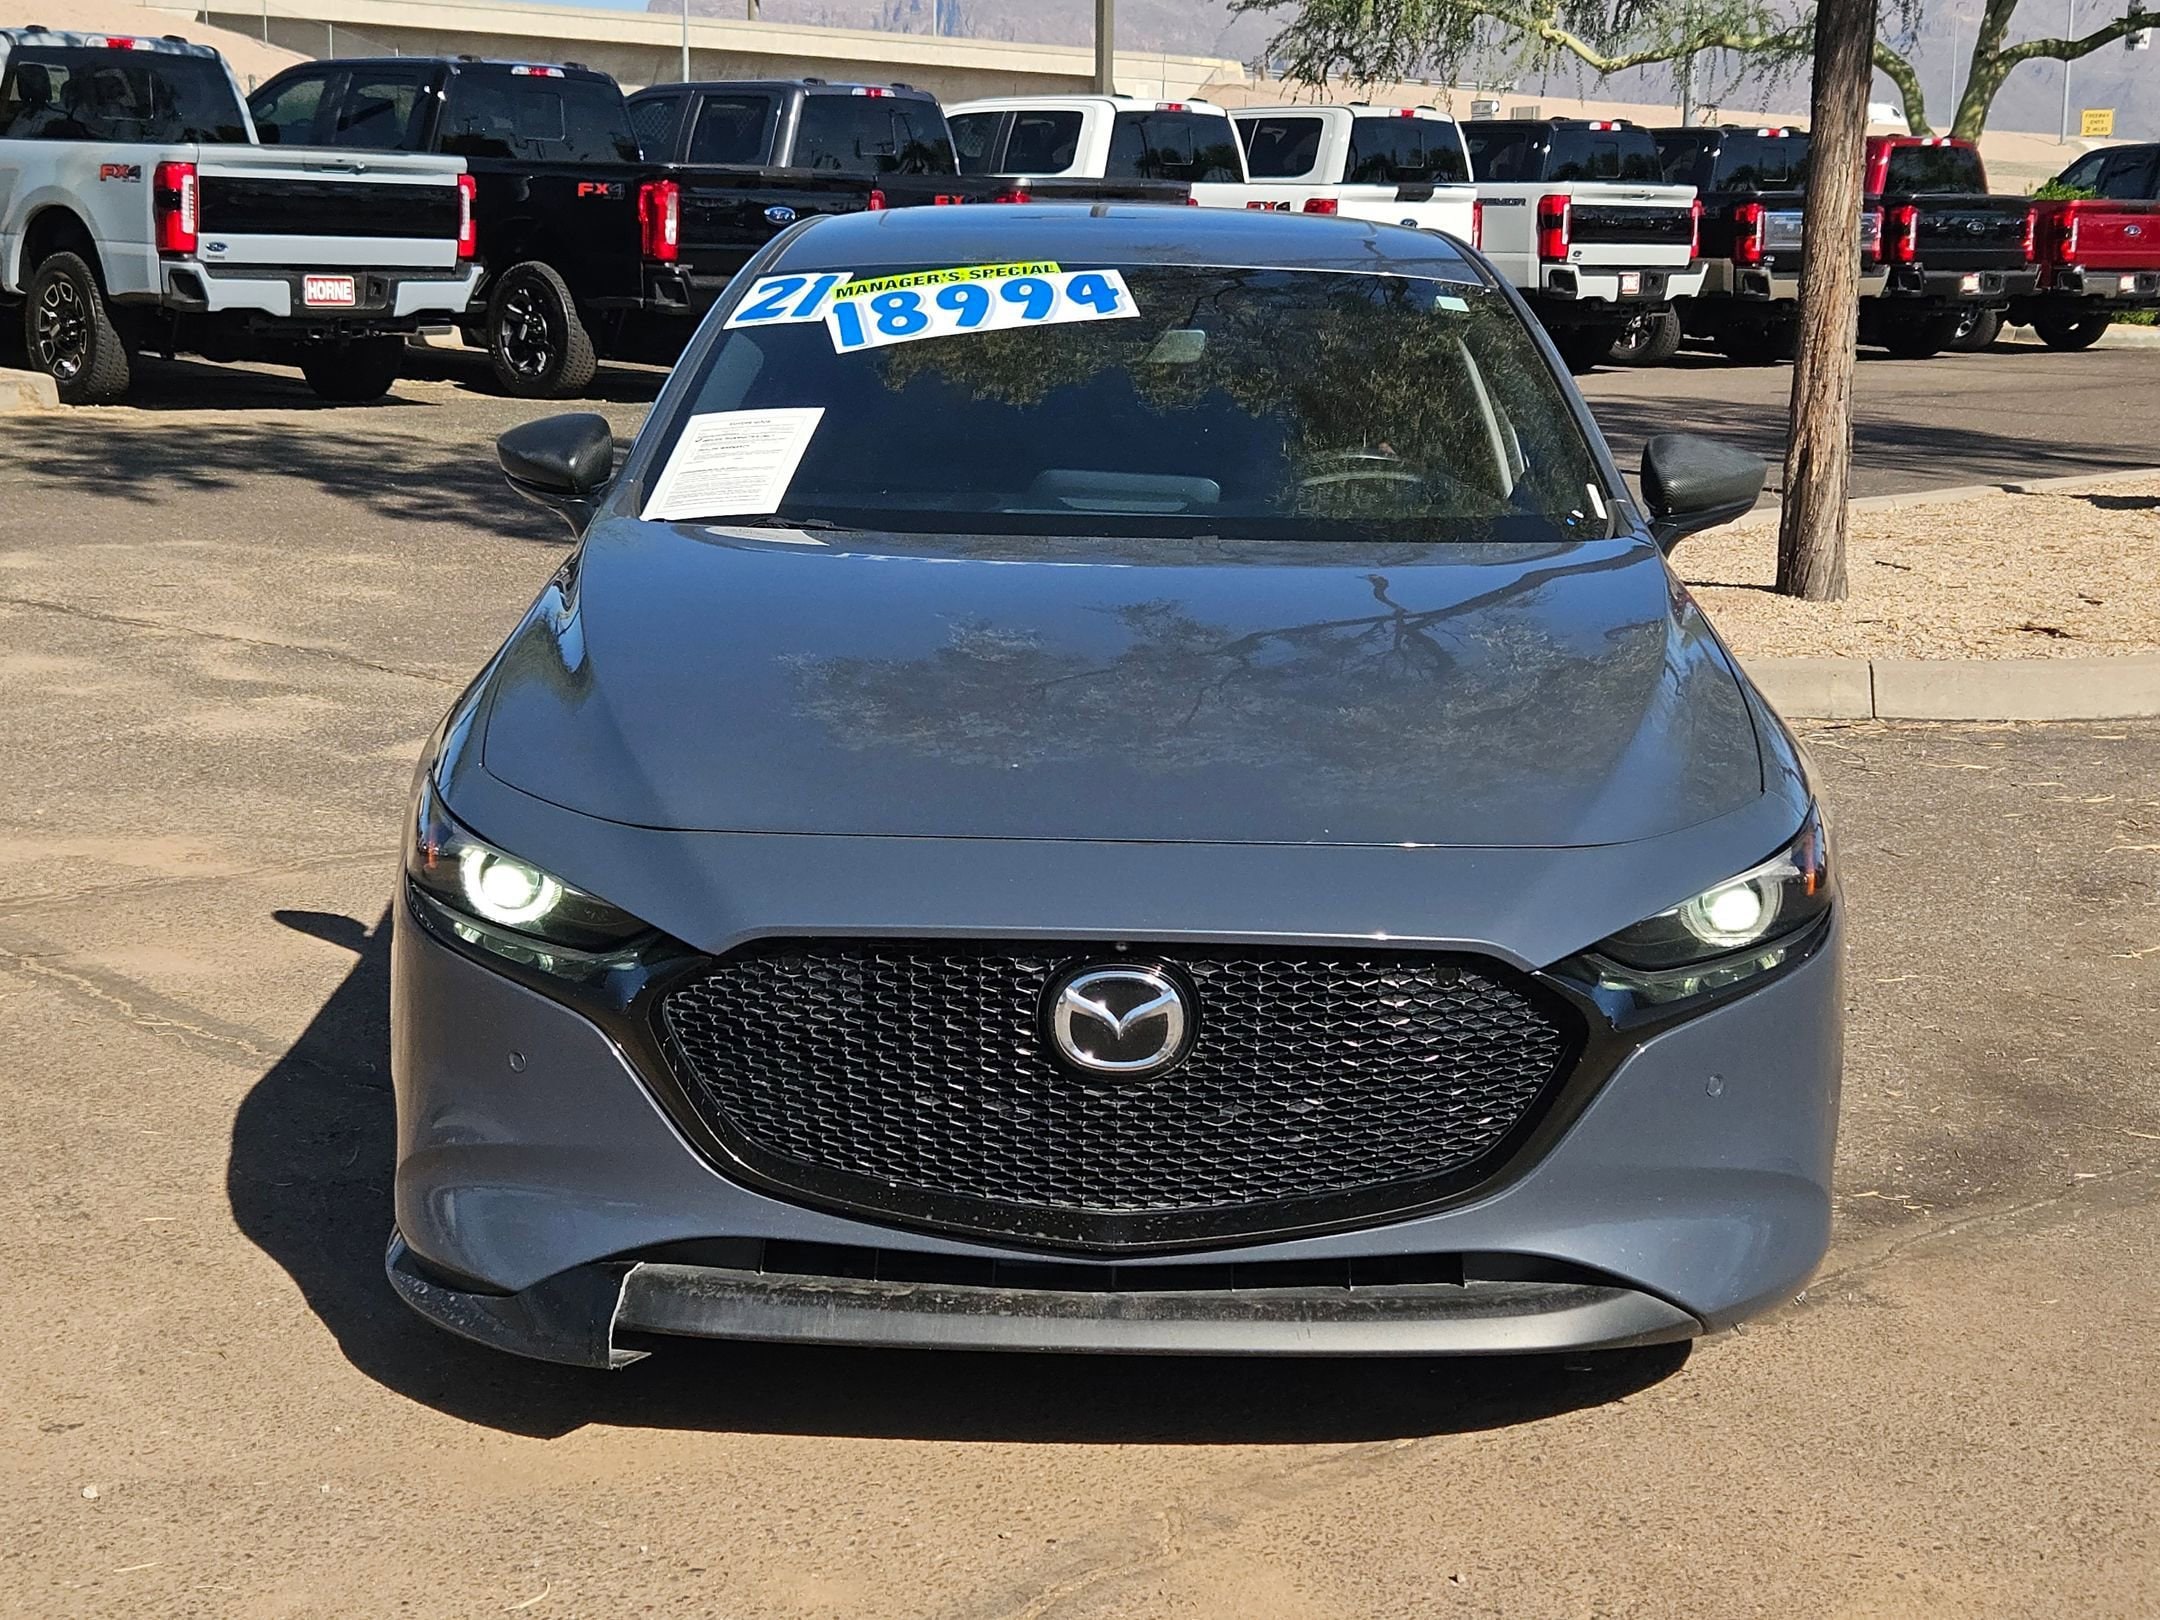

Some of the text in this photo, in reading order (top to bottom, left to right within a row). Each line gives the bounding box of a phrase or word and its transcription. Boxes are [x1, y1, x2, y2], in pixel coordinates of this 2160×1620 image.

[100, 163, 141, 181] FX4
[577, 182, 625, 197] FX4
[308, 280, 353, 302] HORNE
[835, 264, 1057, 299] MANAGER'S SPECIAL
[737, 276, 841, 321] 21
[833, 273, 1121, 348] 18994
